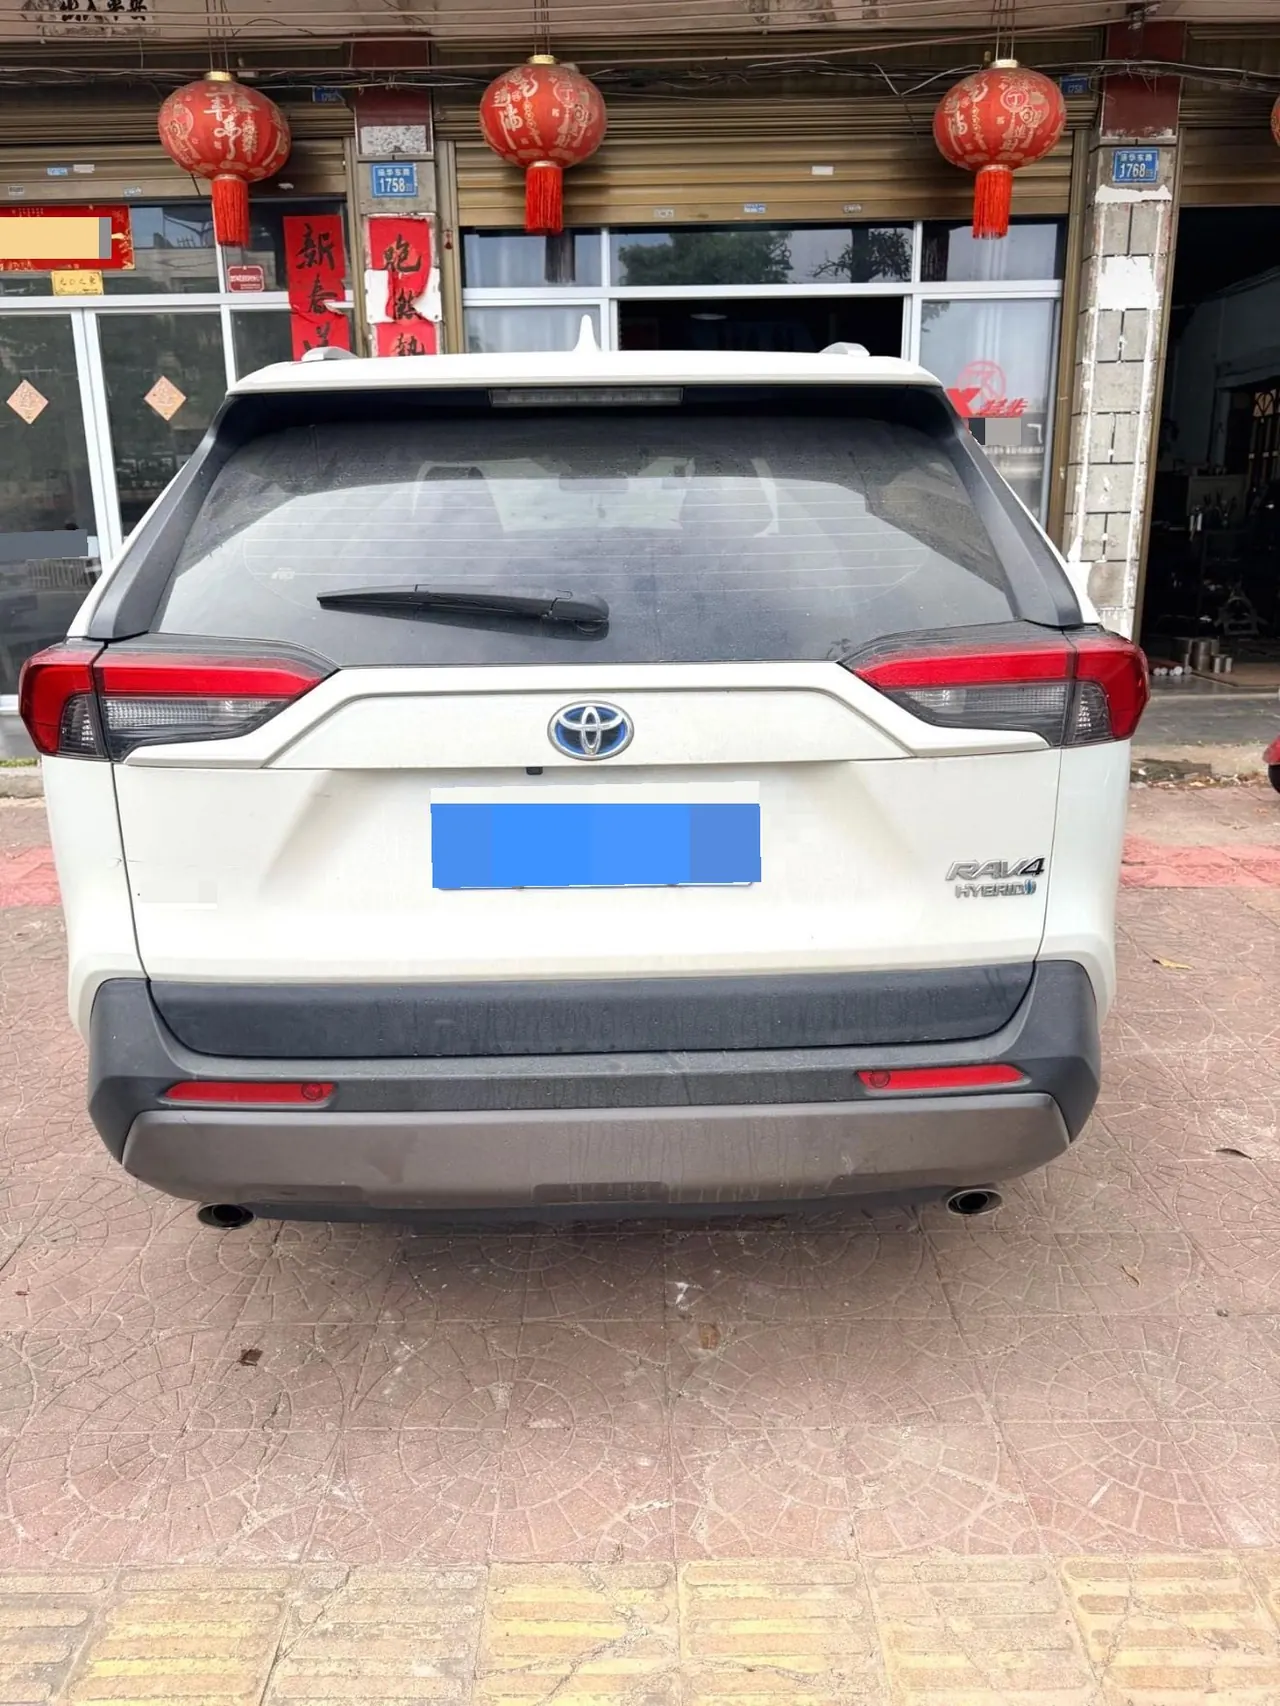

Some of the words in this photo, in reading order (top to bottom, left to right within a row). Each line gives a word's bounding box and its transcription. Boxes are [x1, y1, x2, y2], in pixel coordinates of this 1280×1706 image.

[1119, 162, 1147, 178] 1768
[379, 177, 406, 193] 1758
[945, 857, 1045, 881] RAV4
[955, 882, 1025, 898] HYBRID
